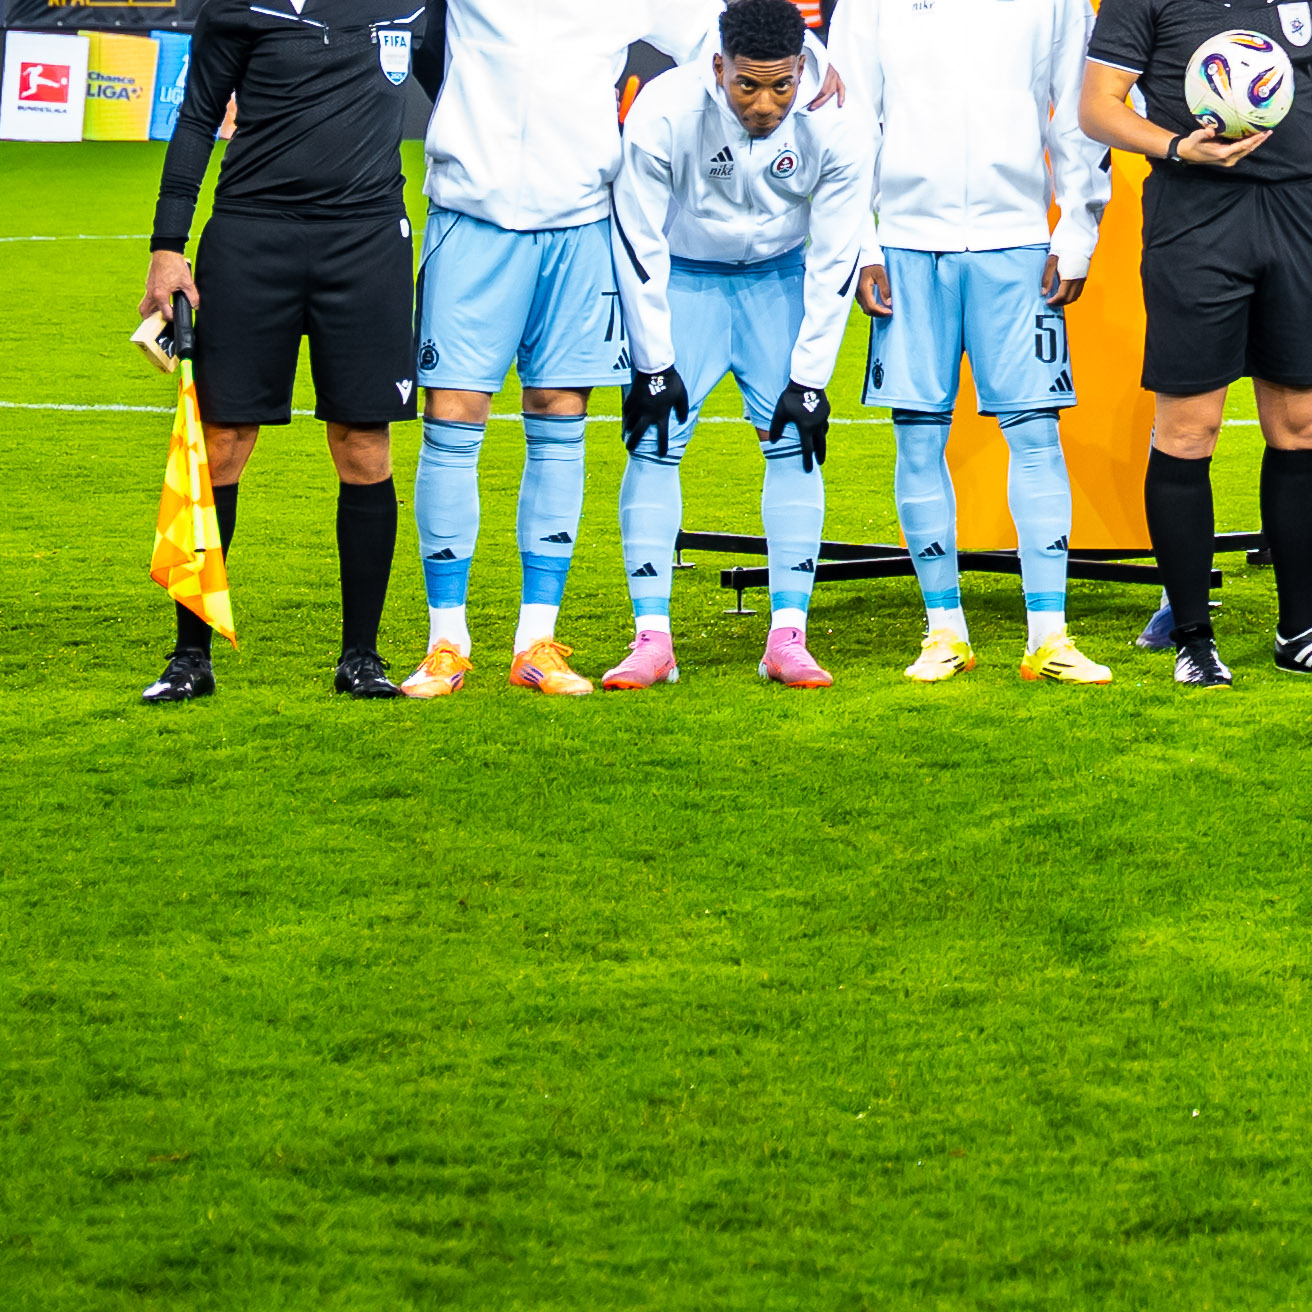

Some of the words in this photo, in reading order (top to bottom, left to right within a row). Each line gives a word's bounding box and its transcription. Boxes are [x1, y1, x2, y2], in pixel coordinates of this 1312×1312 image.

[383, 34, 408, 48] FIFA
[87, 70, 136, 85] Chance
[87, 84, 131, 102] LIGA
